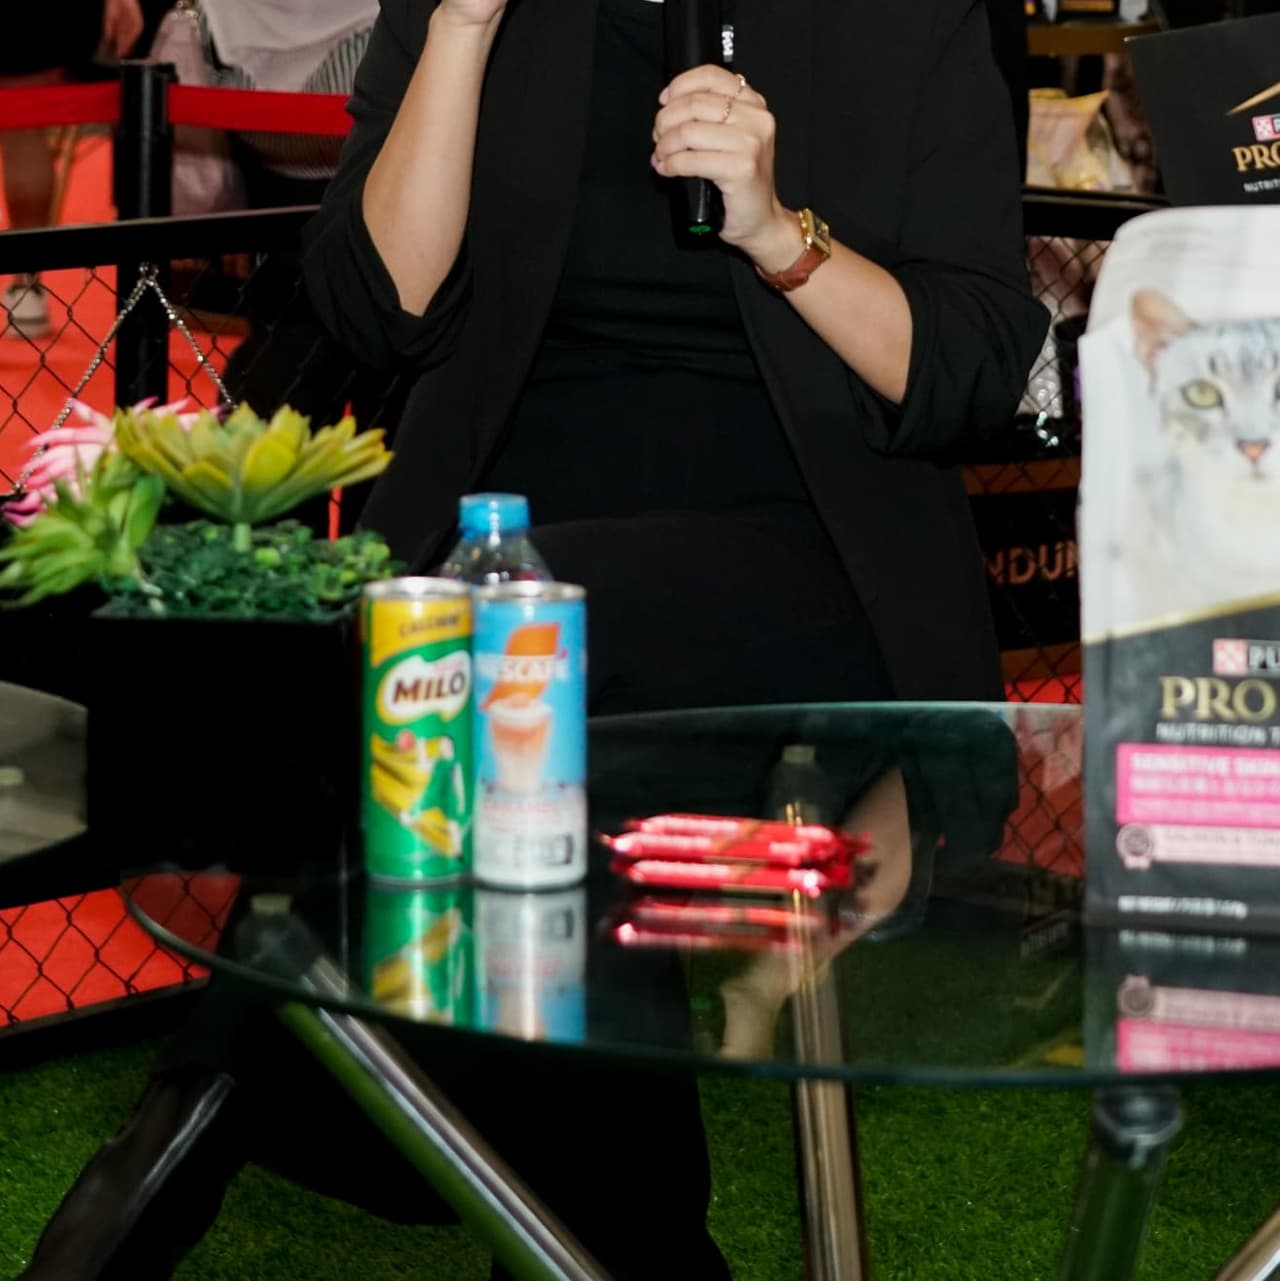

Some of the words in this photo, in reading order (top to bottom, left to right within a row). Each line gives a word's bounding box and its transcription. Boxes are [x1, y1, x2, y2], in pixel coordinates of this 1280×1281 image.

[392, 671, 466, 705] MILO
[1159, 676, 1277, 720] PRO
[1156, 722, 1267, 745] NUTRITION
[1130, 753, 1232, 777] SENSITIVE
